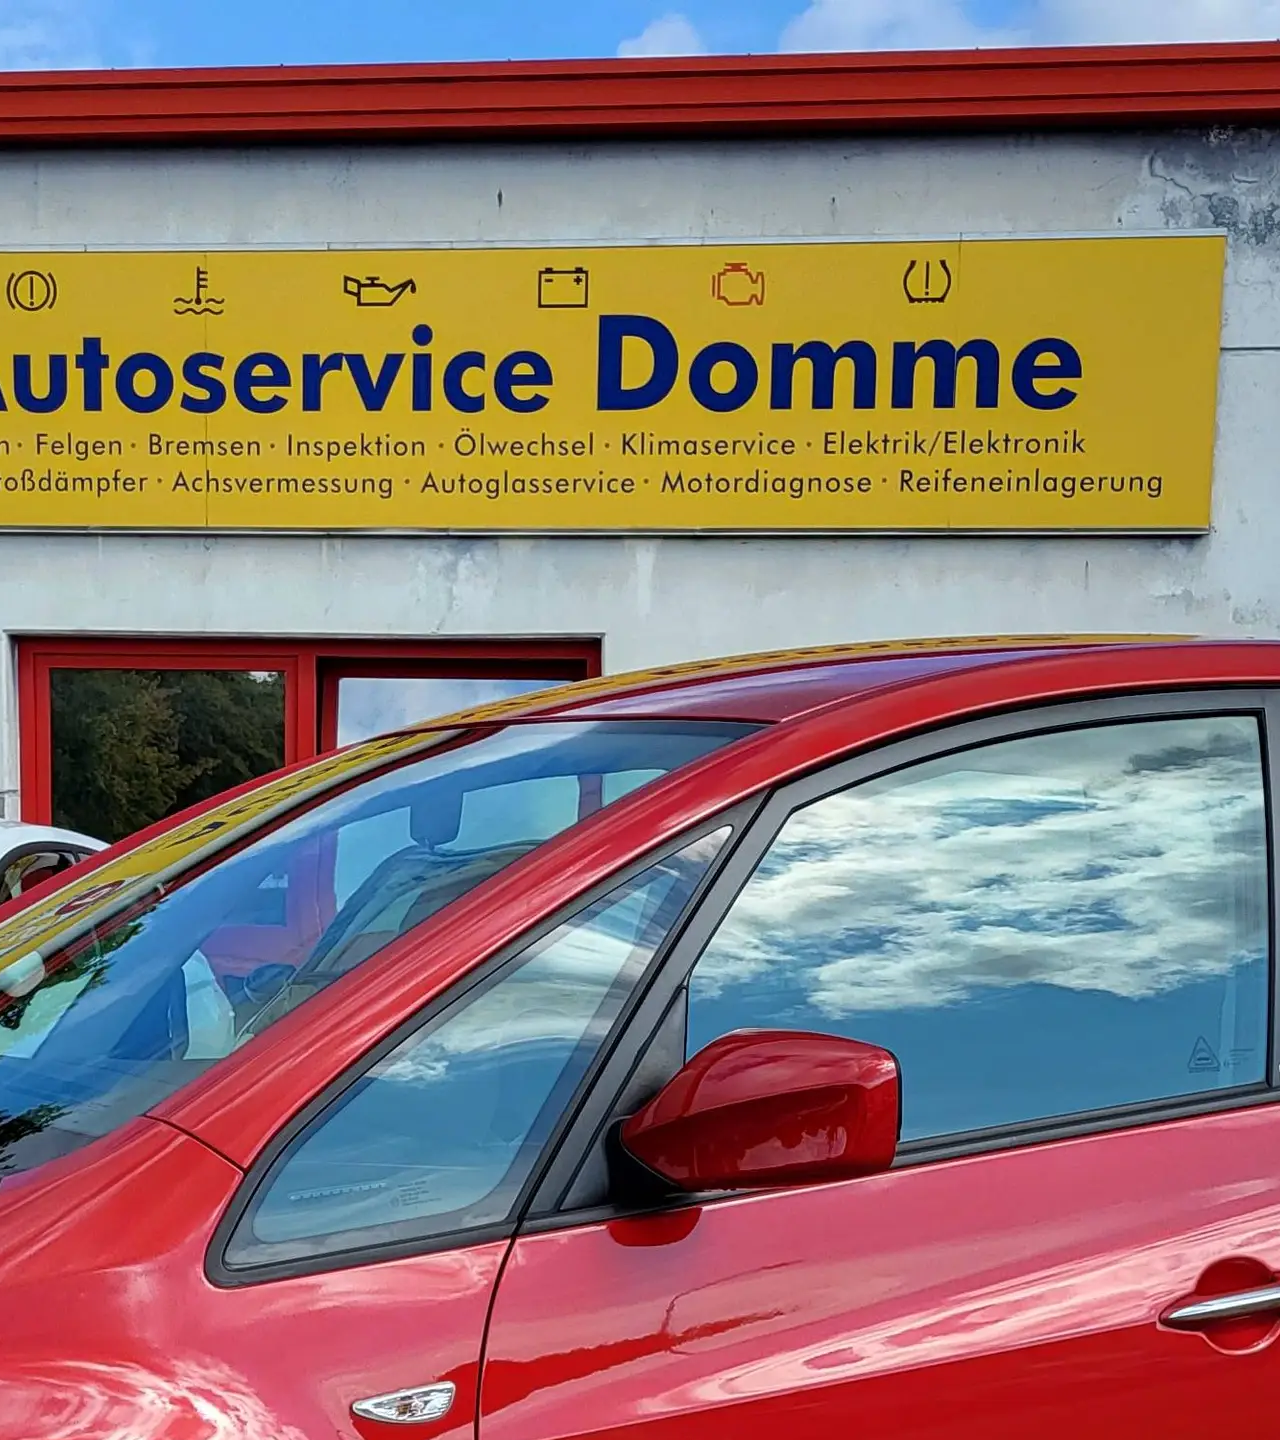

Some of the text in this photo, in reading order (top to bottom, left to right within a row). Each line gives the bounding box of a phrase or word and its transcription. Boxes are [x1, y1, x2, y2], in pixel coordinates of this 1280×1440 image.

[597, 314, 1083, 413] Domme
[36, 432, 123, 461] Felgen
[149, 433, 260, 456] Bremsen
[288, 433, 425, 462] Inspektion
[454, 428, 594, 457] Ölwechsel
[622, 431, 795, 457] Klimaservice
[824, 429, 1086, 457] Elektrik/Elektronik
[171, 470, 393, 500] Achsvermessung
[420, 470, 636, 500] Autoglasservice
[660, 469, 873, 499] Motordiagnose
[899, 468, 1164, 499] Reifeneinlagerung
